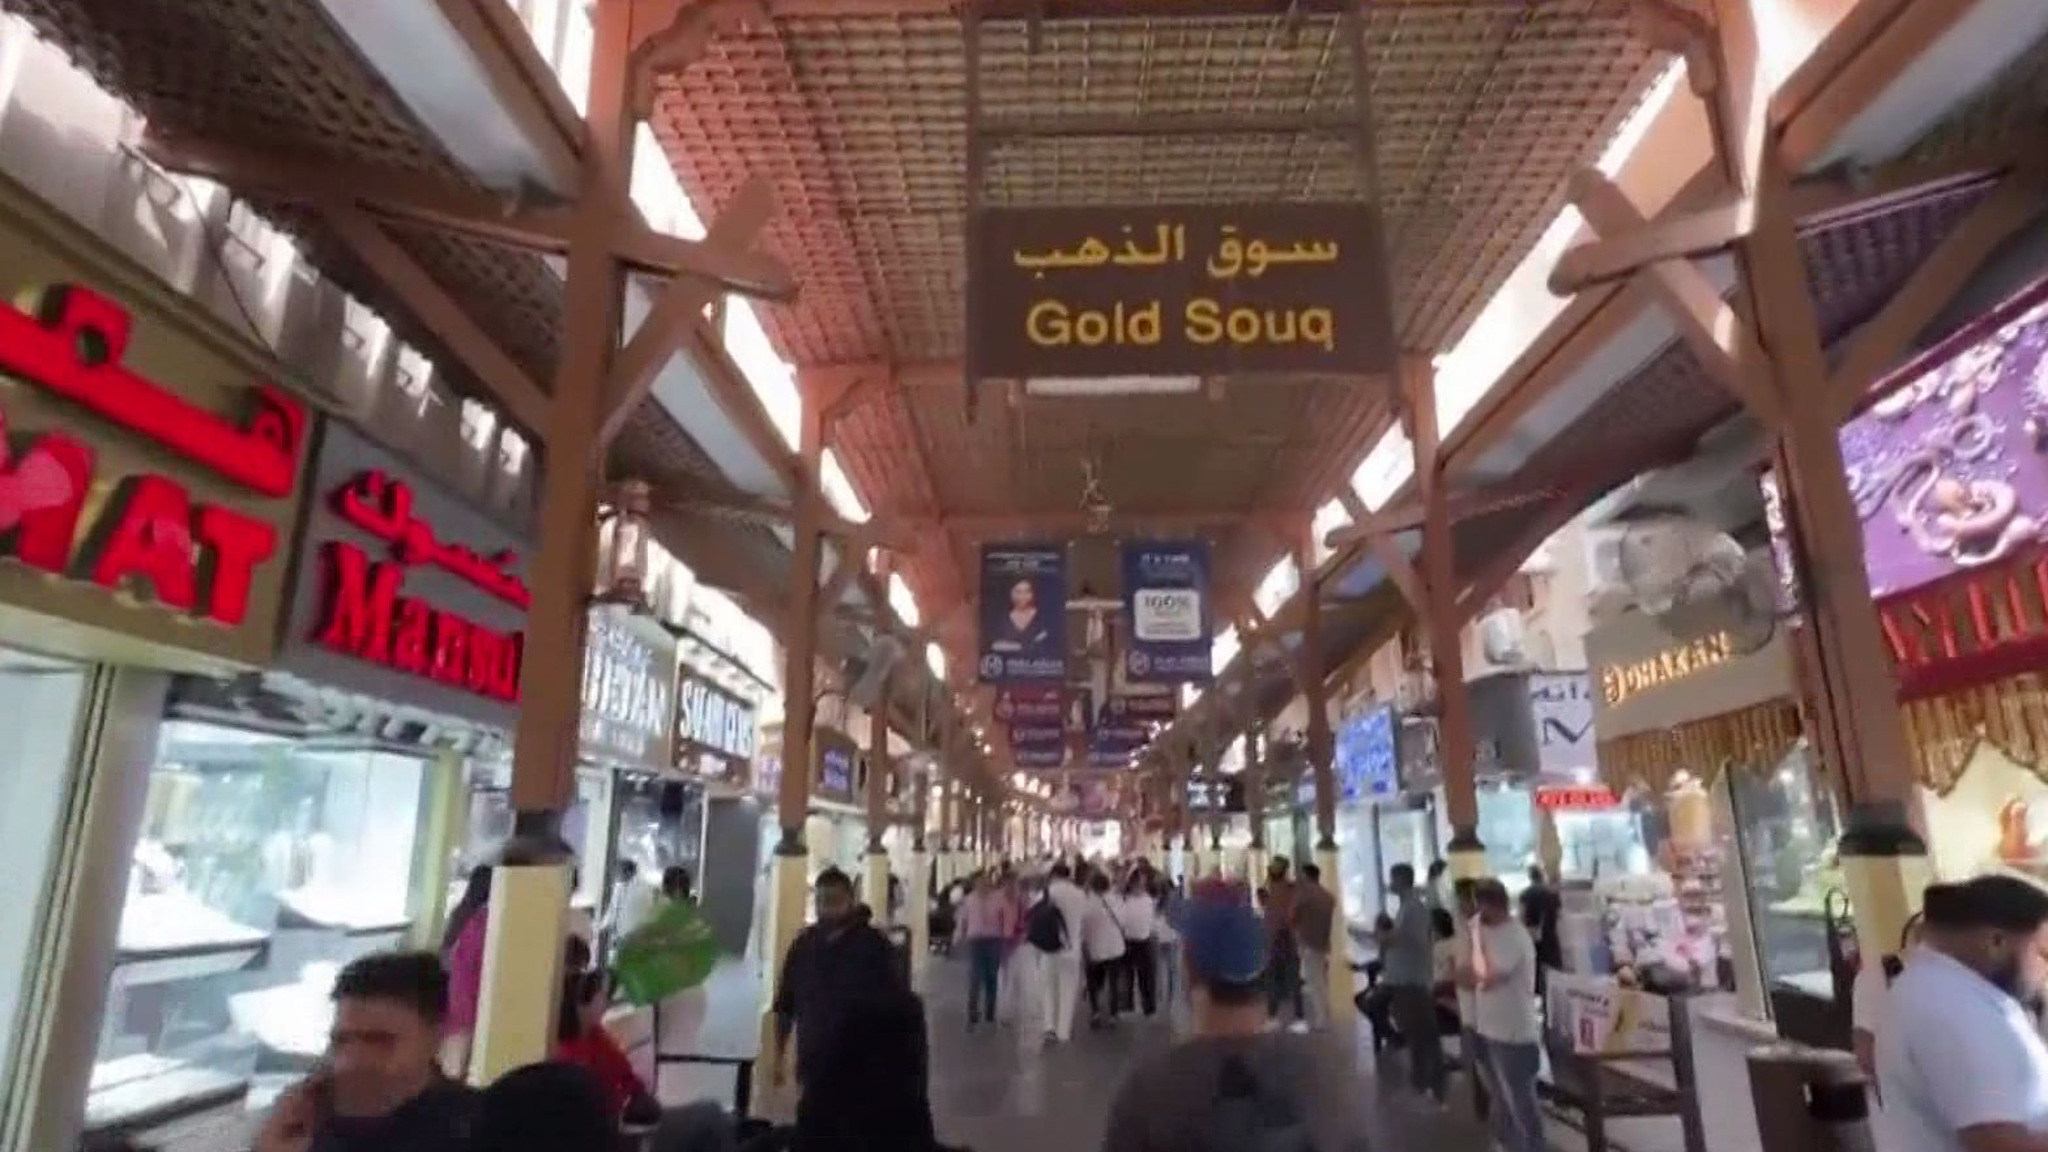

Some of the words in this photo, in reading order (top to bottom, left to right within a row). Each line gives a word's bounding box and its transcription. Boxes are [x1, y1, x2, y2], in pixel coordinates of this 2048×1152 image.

[1013, 224, 1185, 279] الذهب
[1206, 226, 1339, 278] سوق
[1026, 301, 1160, 345] Gold
[1184, 300, 1333, 352] Souq
